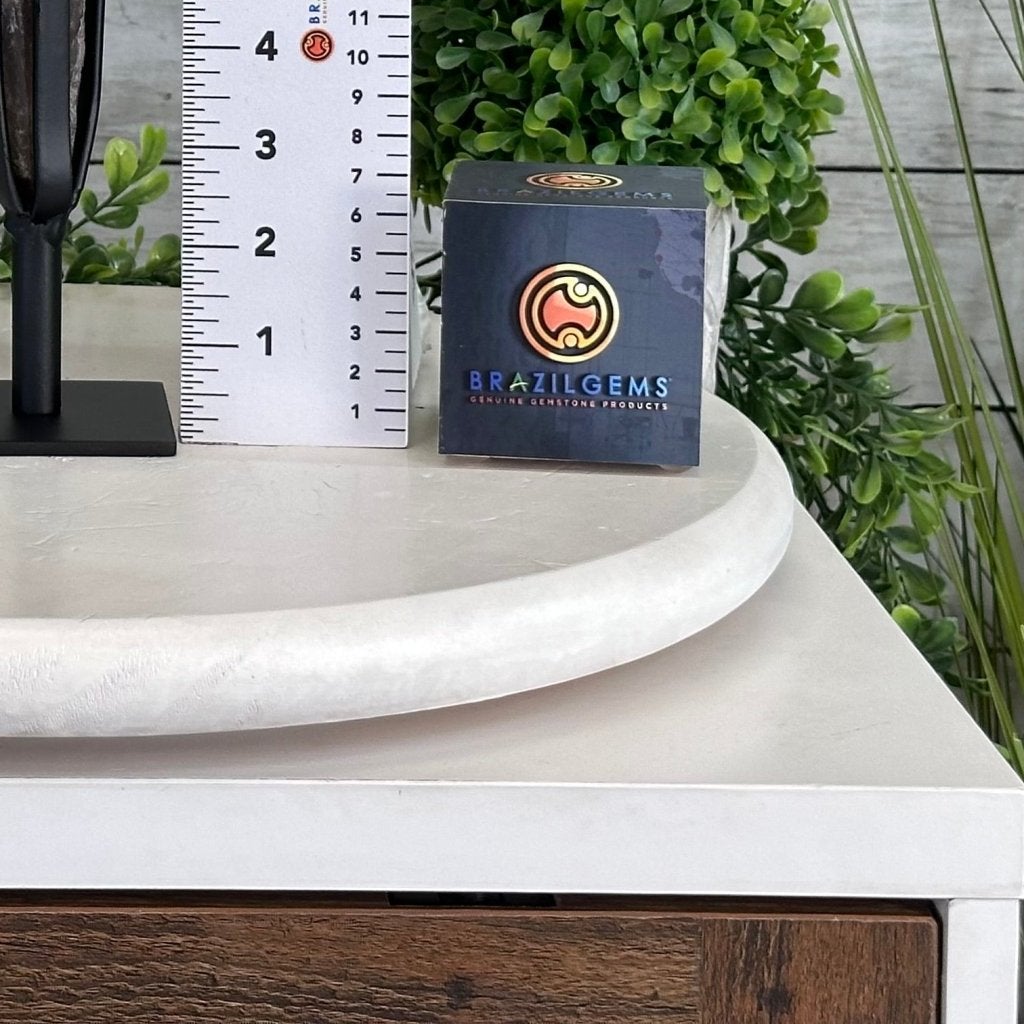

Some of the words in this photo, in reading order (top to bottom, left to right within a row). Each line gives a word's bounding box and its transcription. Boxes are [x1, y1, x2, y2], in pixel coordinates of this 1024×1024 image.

[348, 9, 369, 26] 11
[255, 30, 278, 62] 4
[346, 49, 369, 66] 10
[351, 88, 363, 105] 9
[255, 128, 277, 160] 3
[351, 128, 363, 145] 8
[351, 168, 363, 184] 7
[350, 207, 362, 223] 6
[254, 226, 276, 258] 2
[350, 246, 362, 263] 5
[349, 285, 362, 302] 4
[350, 324, 361, 341] 3
[256, 326, 272, 357] 1
[349, 364, 361, 381] 2
[469, 370, 669, 397] BRAZILGEMS
[351, 403, 359, 419] 1
[470, 395, 523, 405] GENUINE
[530, 398, 596, 408] GEMSTONE
[602, 401, 669, 411] PRODUCTS
